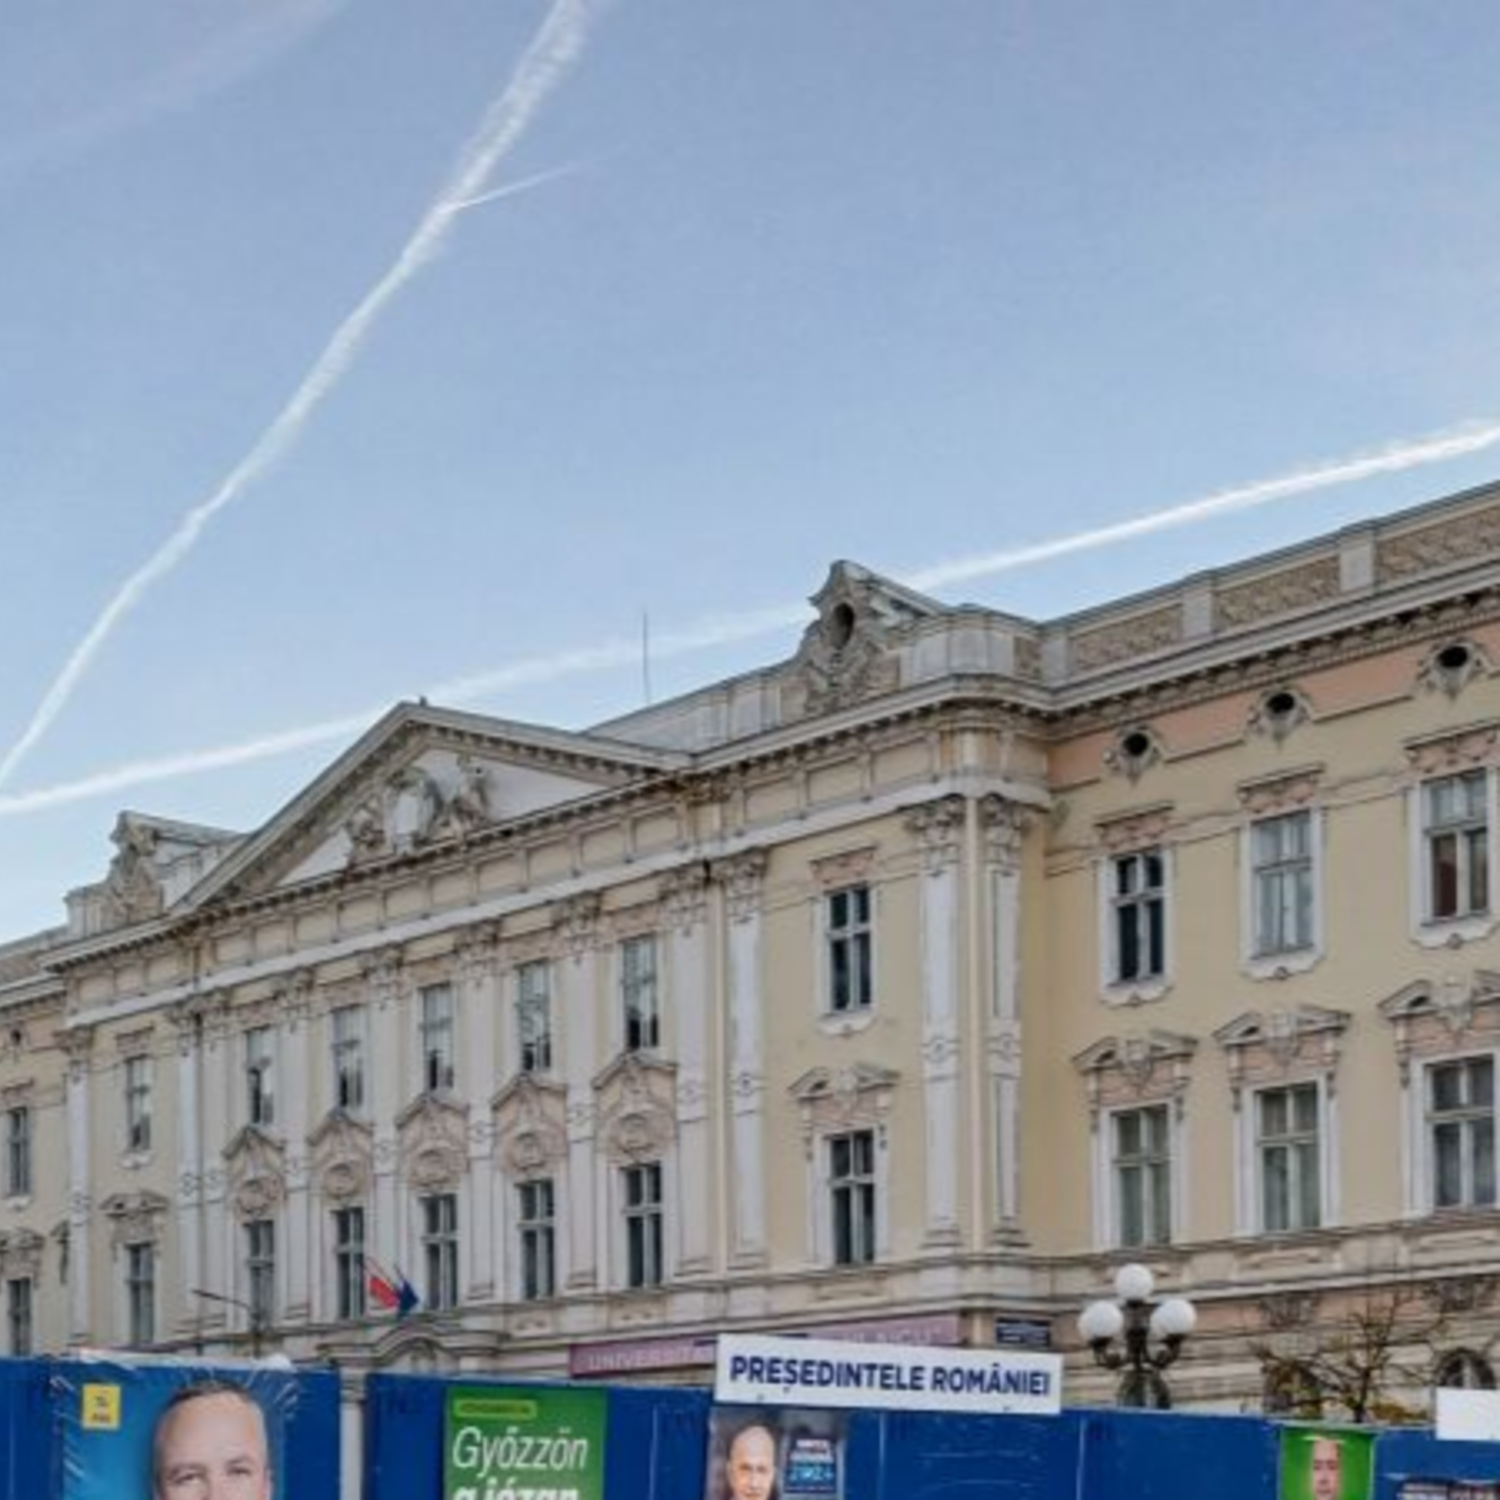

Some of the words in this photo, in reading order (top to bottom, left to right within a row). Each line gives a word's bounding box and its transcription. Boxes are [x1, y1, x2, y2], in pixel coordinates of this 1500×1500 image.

[730, 1355, 926, 1393] PREȘEDINTELE
[933, 1363, 1051, 1396] ROMÂNIEI
[453, 1426, 589, 1478] Győzzön
